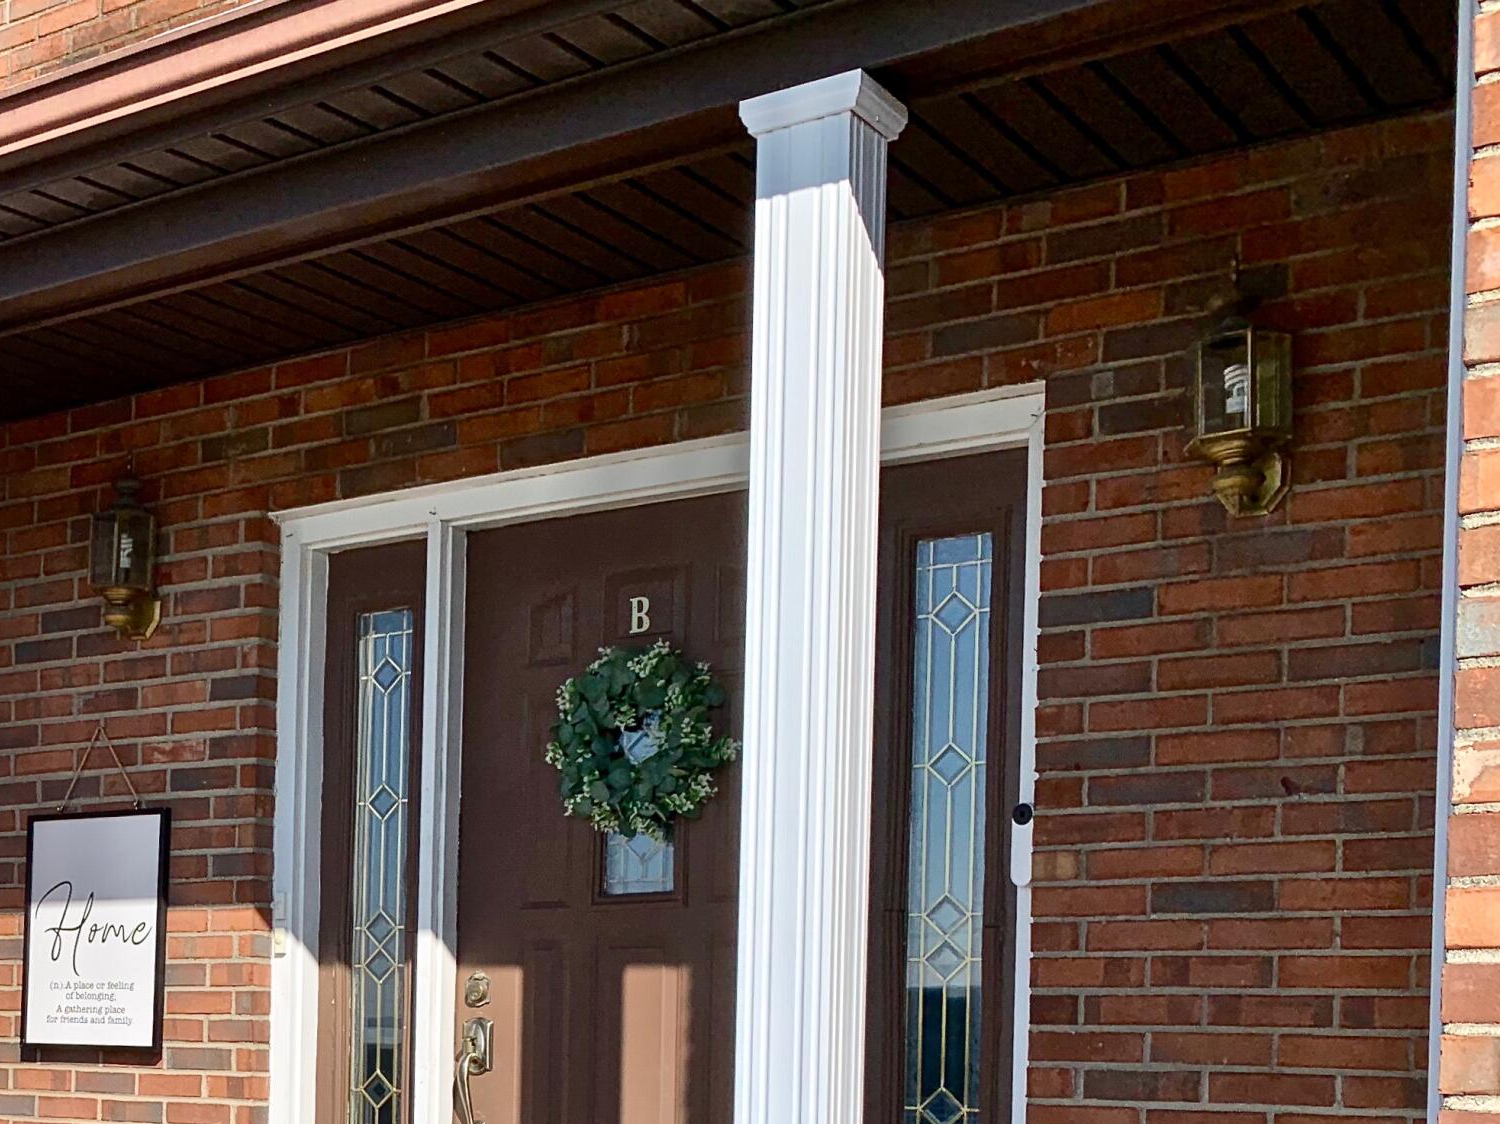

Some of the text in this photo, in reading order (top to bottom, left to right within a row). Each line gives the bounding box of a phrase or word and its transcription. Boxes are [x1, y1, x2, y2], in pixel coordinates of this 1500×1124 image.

[629, 596, 650, 634] B
[35, 881, 152, 976] Home
[73, 980, 94, 991] place
[96, 982, 105, 990] or
[107, 980, 135, 991] feeling
[66, 991, 74, 1000] of
[56, 1004, 126, 1015] A gathering place
[46, 1015, 133, 1026] for friends and family
